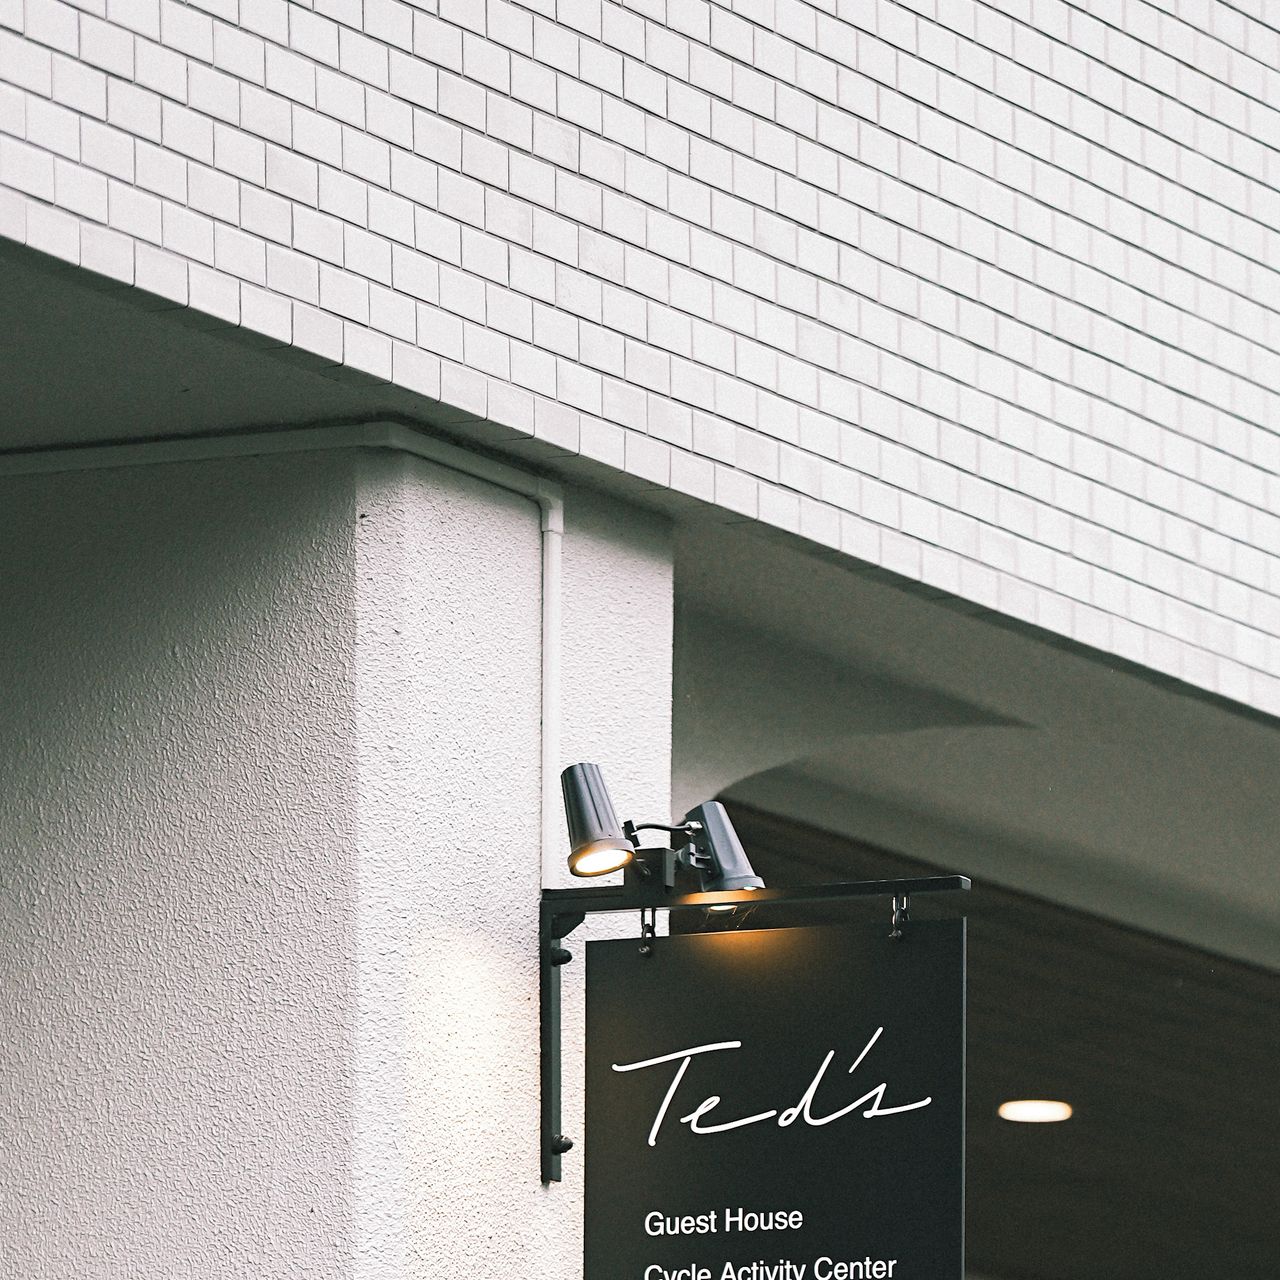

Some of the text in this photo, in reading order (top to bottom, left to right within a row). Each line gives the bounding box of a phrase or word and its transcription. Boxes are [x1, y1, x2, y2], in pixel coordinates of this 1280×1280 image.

[611, 1026, 932, 1147] Ted's
[643, 1207, 804, 1237] Guest House
